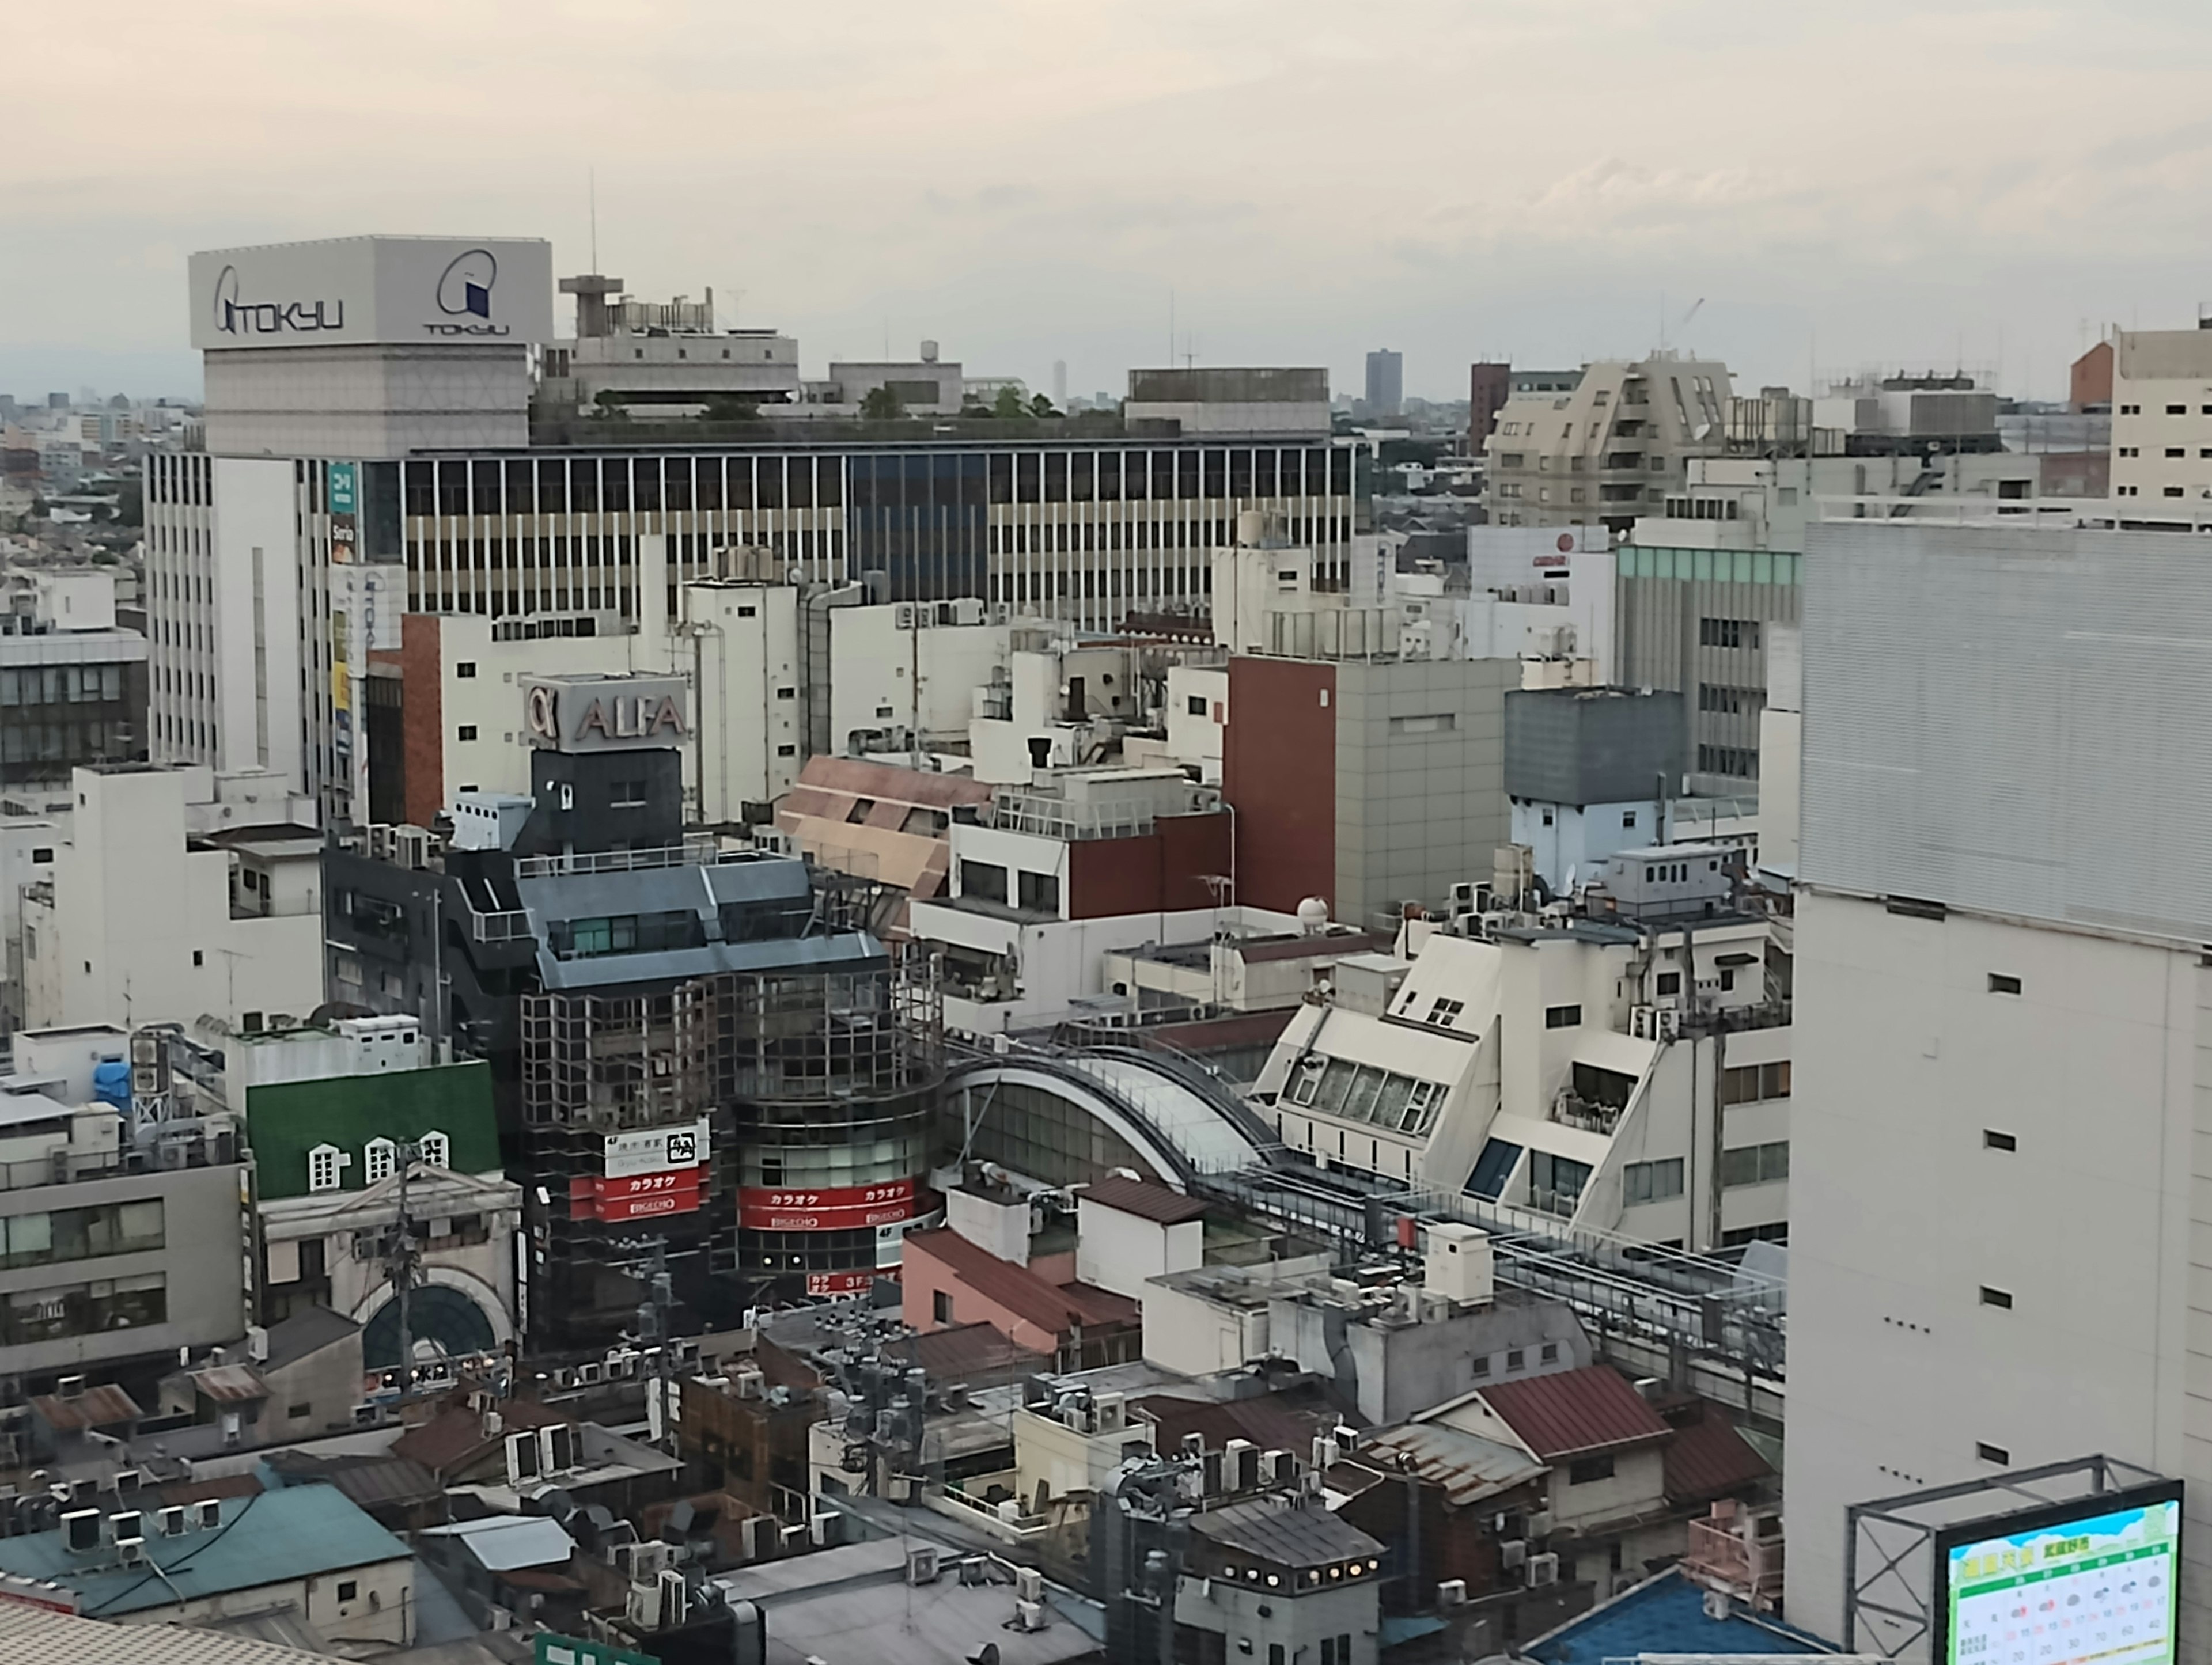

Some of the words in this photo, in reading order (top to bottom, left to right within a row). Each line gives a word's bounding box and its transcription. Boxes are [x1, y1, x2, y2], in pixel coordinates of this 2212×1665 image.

[234, 298, 344, 334] TOKYU
[422, 324, 510, 336] TOKYU
[332, 525, 355, 542] Seria
[575, 693, 687, 741] ALFA
[630, 1175, 676, 1192] カラオケ
[771, 1194, 819, 1205] カラオケ
[865, 1186, 906, 1201] カラオケ
[879, 1227, 892, 1237] 4F
